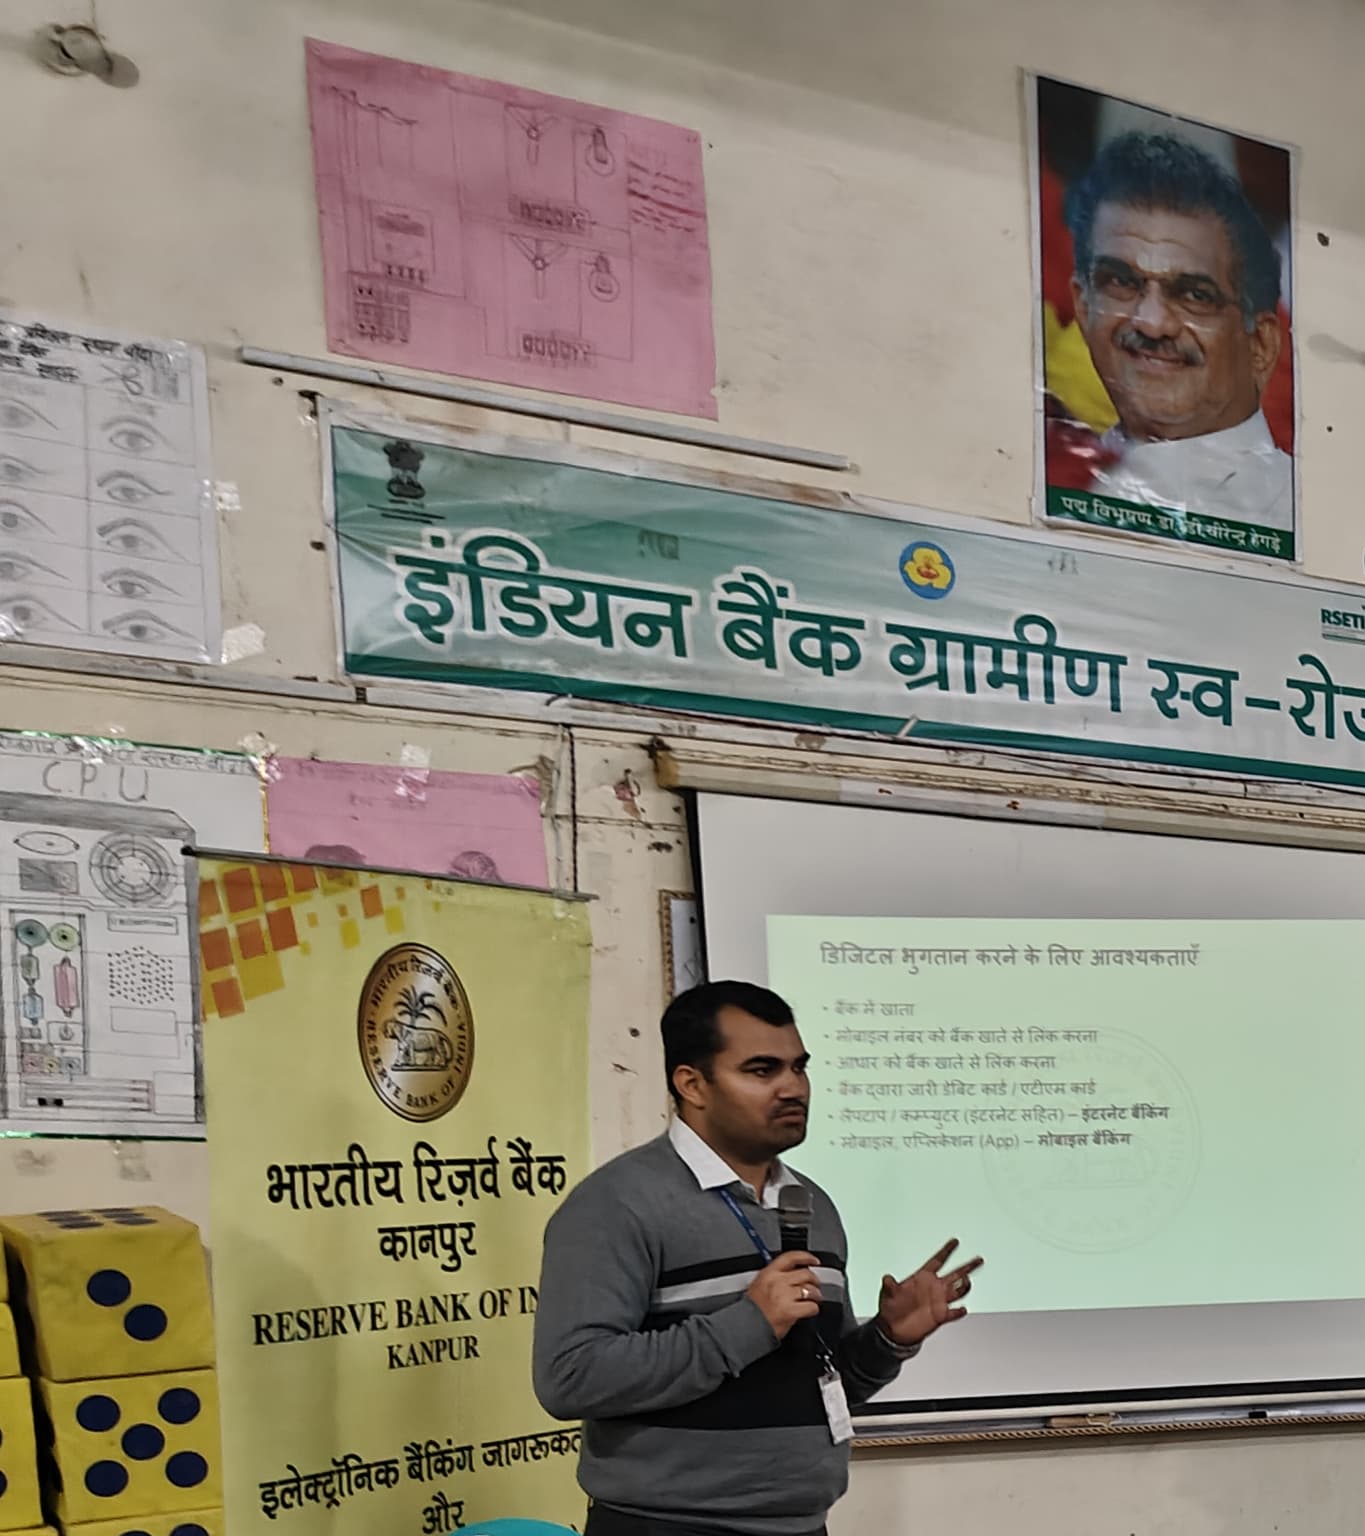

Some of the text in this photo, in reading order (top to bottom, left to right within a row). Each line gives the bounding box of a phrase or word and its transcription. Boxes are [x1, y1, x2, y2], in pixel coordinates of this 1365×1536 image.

[396, 530, 691, 661] इंडियन
[720, 572, 864, 678] बैंक
[888, 614, 1126, 713] ग्रामीण
[1321, 608, 1365, 630] RSETI
[820, 941, 896, 965] डिजिटल
[901, 947, 970, 976] भुगतान
[975, 944, 1018, 966] करने
[1024, 944, 1042, 966] के
[1047, 943, 1084, 966] लिए
[266, 1136, 567, 1210] भारतीय रिज़र्व बैंक
[377, 1221, 477, 1272] कानपुर
[251, 1302, 389, 1346] RESERVE
[396, 1292, 473, 1329] BANK
[478, 1287, 511, 1319] OF
[387, 1335, 480, 1370] KANPUR
[258, 1452, 400, 1520] इलेक्ट्रॉनिक
[406, 1439, 475, 1484] बैंकिंग
[421, 1490, 466, 1536] और
